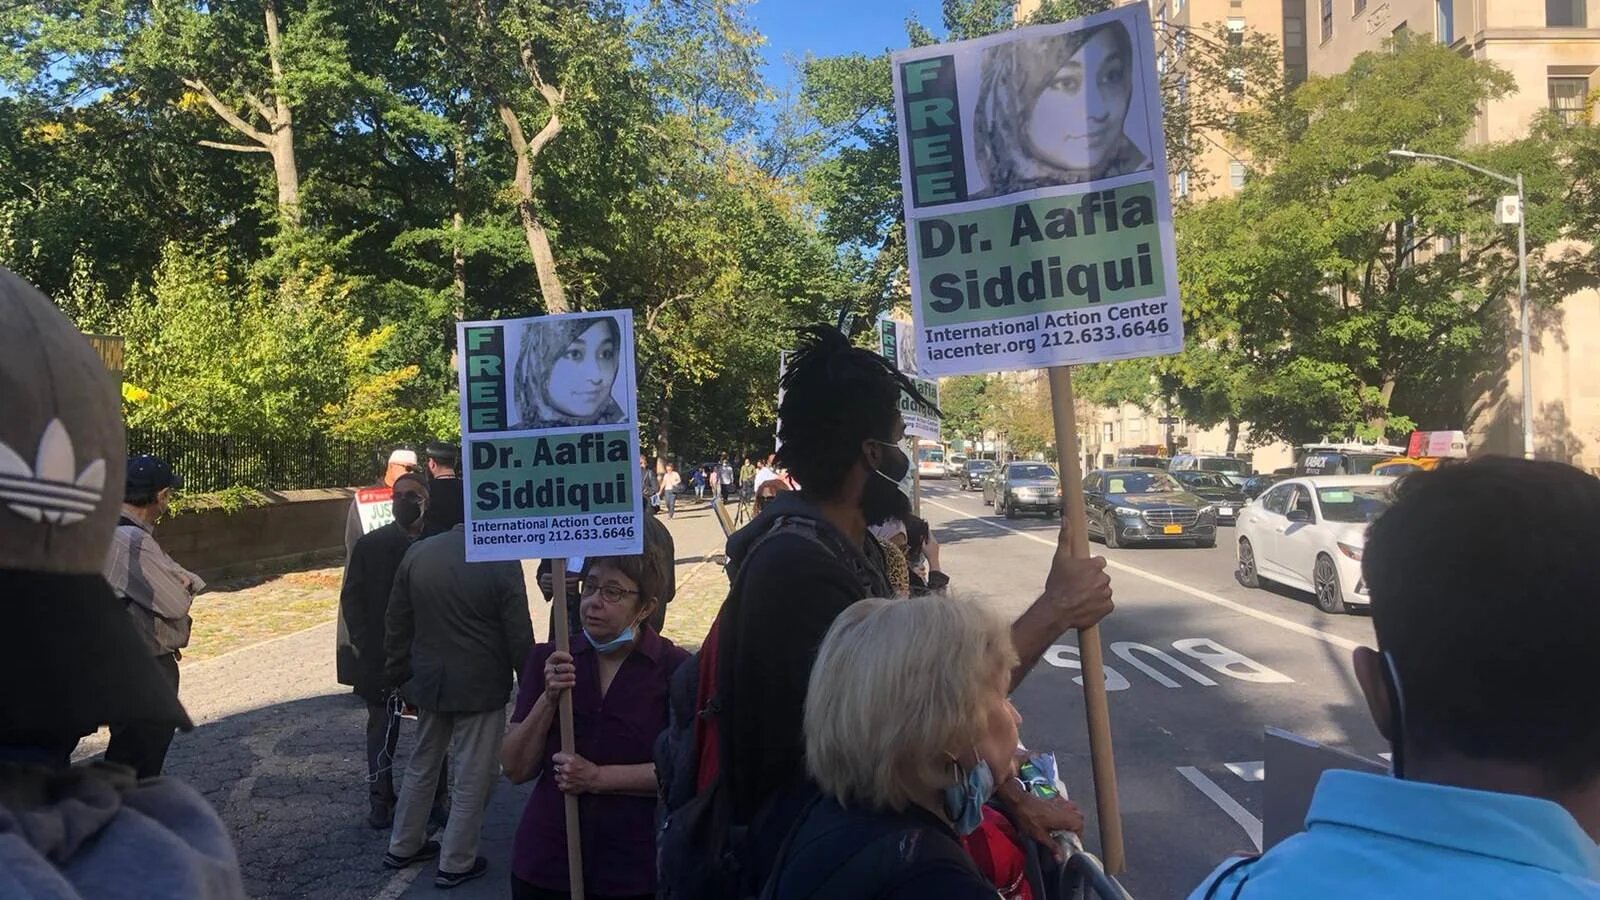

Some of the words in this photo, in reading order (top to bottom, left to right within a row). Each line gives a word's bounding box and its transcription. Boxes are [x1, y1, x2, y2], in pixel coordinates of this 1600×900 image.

[905, 59, 955, 202] FREE
[918, 218, 992, 260] Dr.
[1010, 190, 1154, 248] Aafia
[928, 242, 1154, 314] Siddiqui
[883, 321, 896, 364] FRE
[925, 316, 1039, 344] International
[1045, 312, 1101, 329] Action
[1107, 300, 1169, 321] Center
[928, 337, 1036, 361] iacenter.org
[1041, 318, 1169, 348] 212.633.6646
[468, 328, 502, 430] FREE
[472, 441, 522, 470] Dr.
[533, 433, 629, 467] Aafia
[371, 503, 393, 519] JUS
[476, 473, 627, 511] Siddiqui
[472, 519, 548, 533] International
[551, 517, 589, 529] Action
[593, 515, 636, 526] Center
[473, 532, 546, 545] iacenter.org
[549, 526, 634, 542] 212.633.6646
[1043, 638, 1296, 691] BUS
